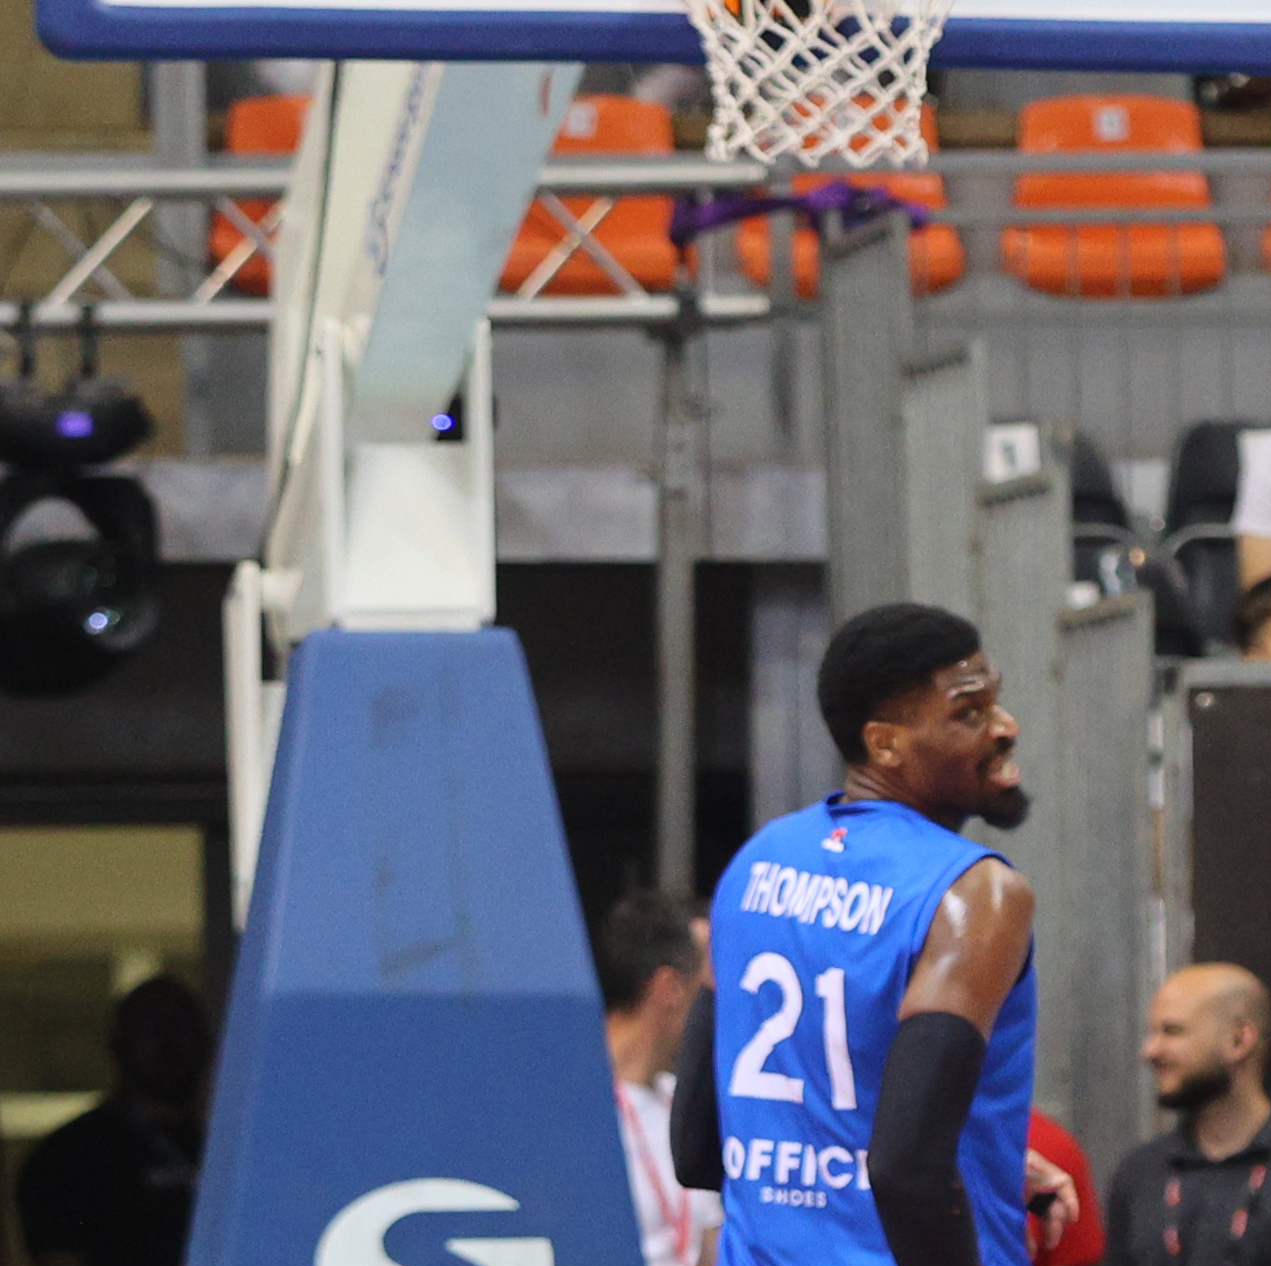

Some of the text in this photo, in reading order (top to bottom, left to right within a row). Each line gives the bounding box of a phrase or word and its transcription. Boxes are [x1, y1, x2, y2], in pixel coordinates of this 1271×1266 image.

[740, 861, 895, 936] THOMPSON
[728, 951, 858, 1110] 21
[759, 1186, 828, 1208] SHOES
